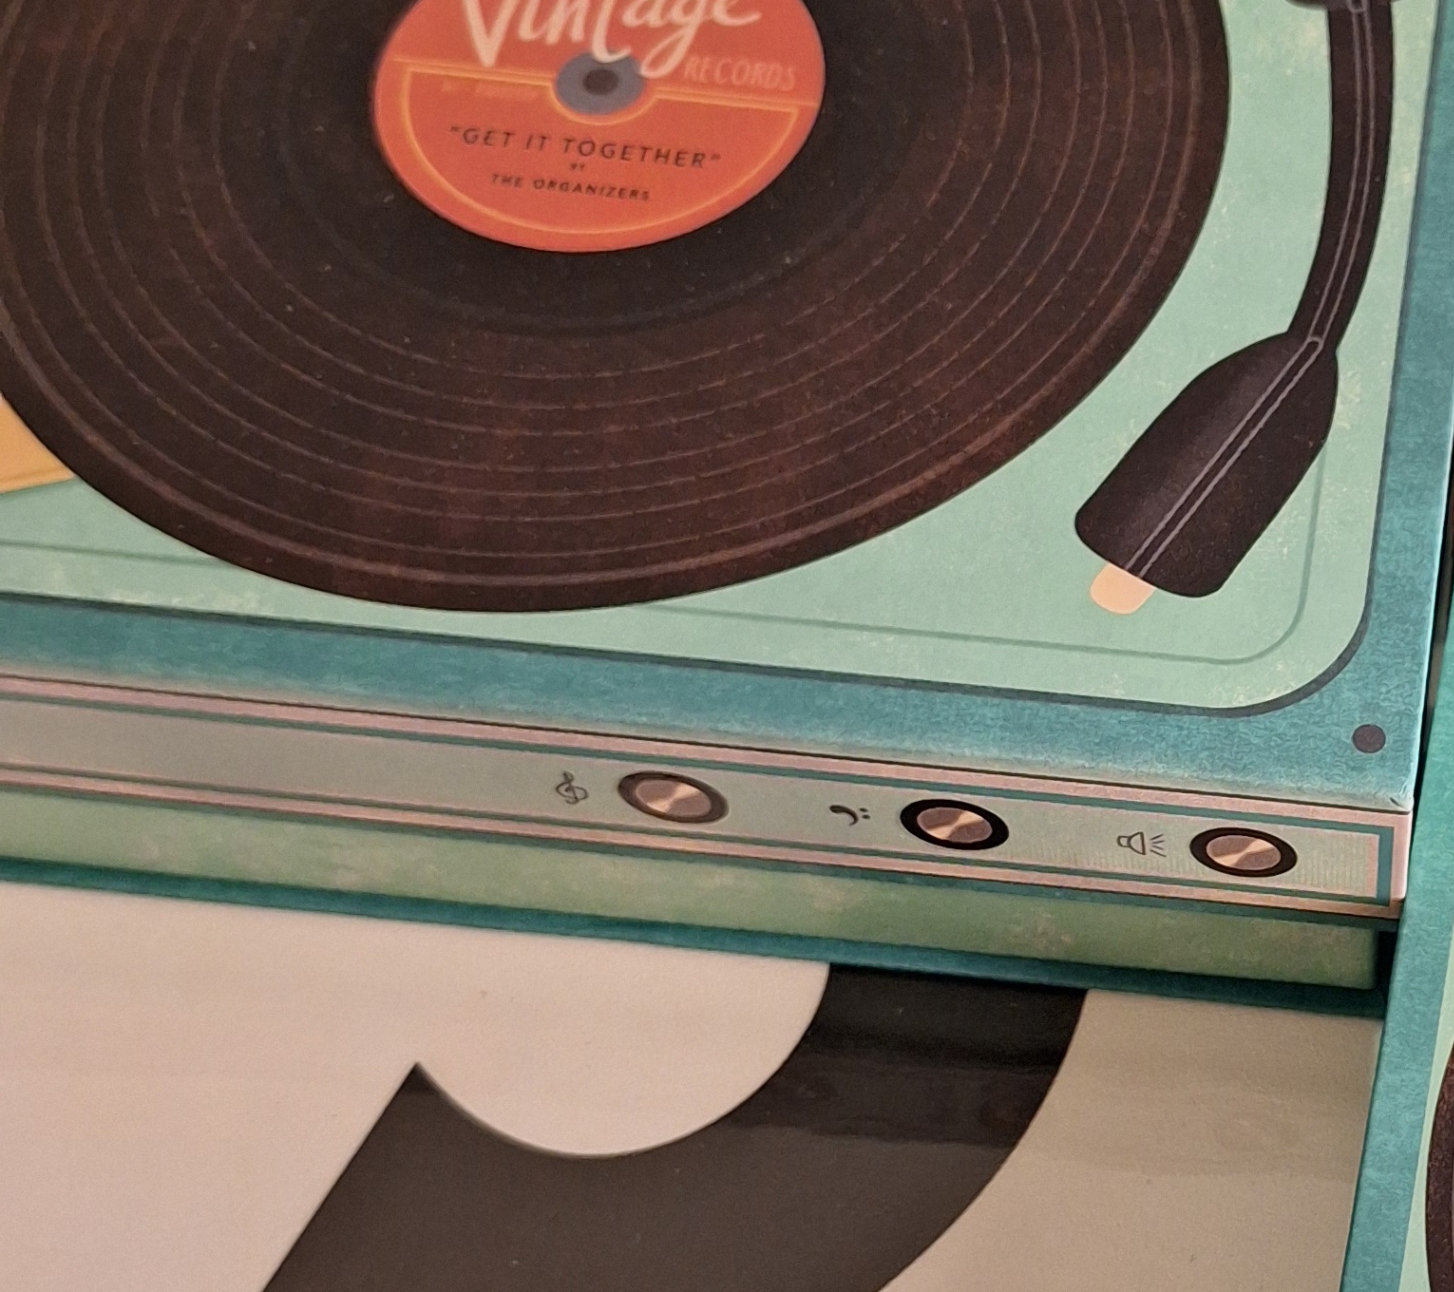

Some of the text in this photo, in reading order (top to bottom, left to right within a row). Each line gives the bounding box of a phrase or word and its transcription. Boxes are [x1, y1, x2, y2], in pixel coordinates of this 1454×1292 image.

[684, 57, 796, 91] RECORDS
[526, 133, 551, 152] IT
[492, 173, 650, 202] THE ORGANIZERS
